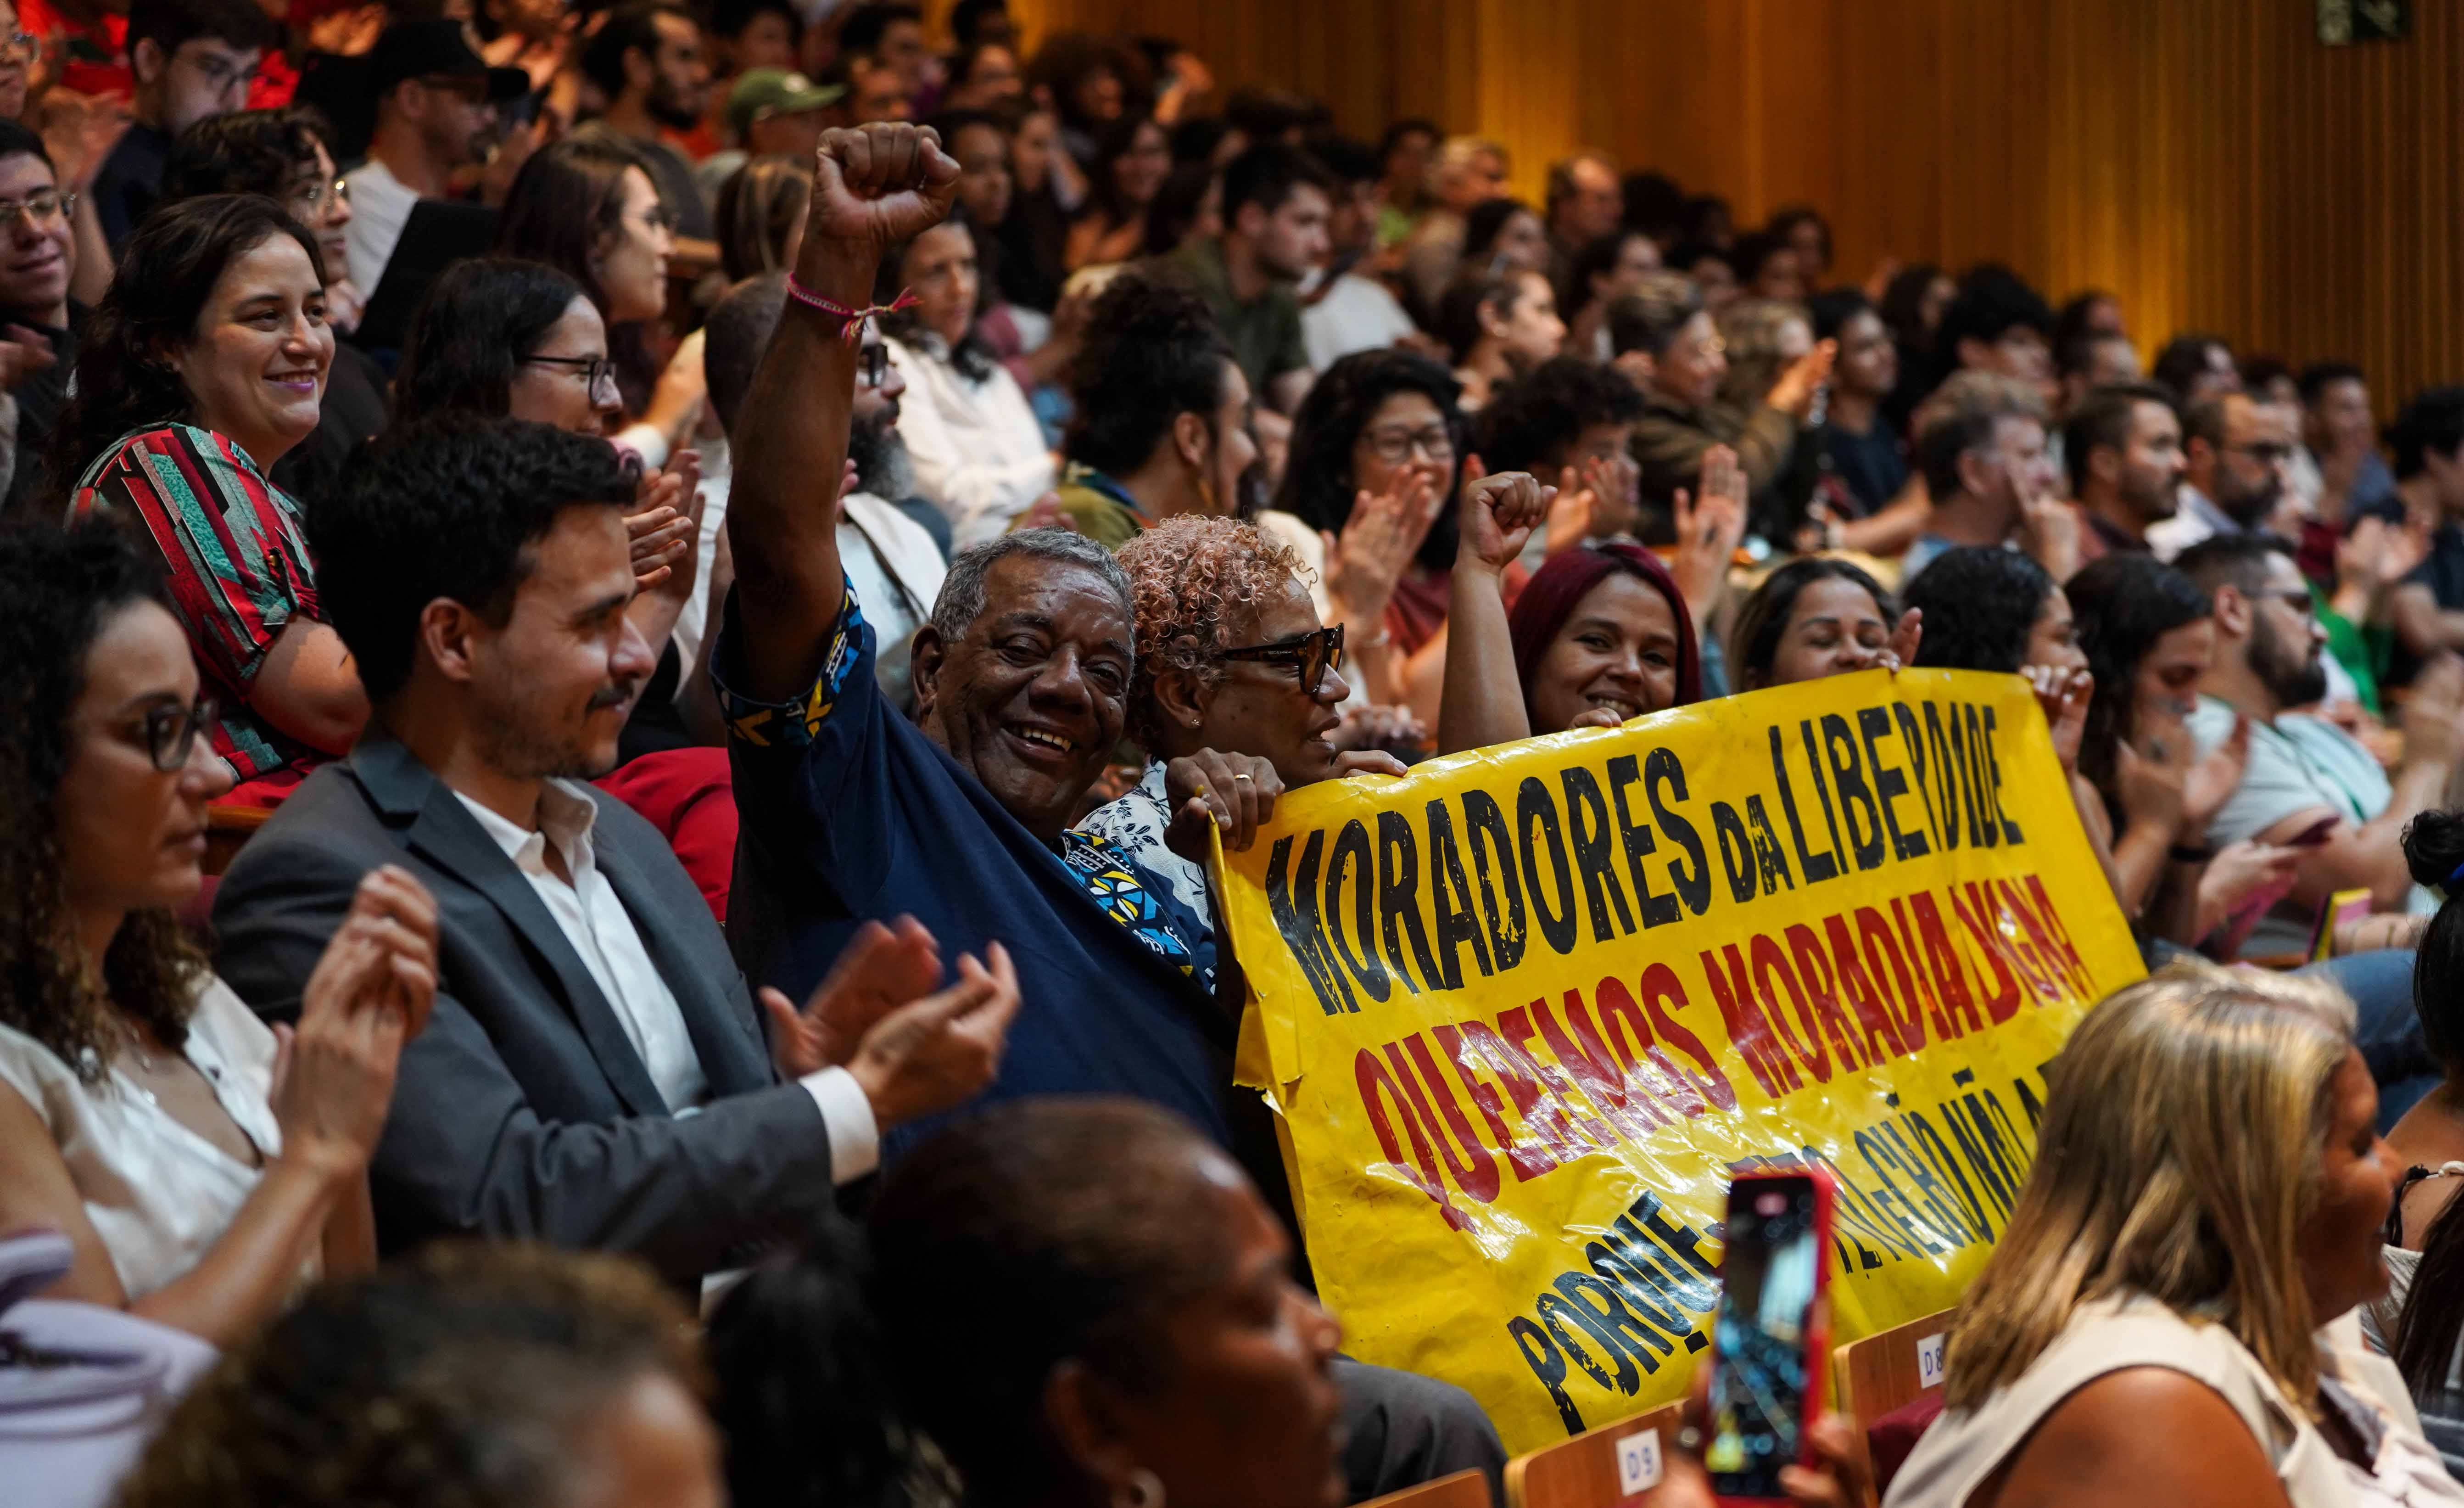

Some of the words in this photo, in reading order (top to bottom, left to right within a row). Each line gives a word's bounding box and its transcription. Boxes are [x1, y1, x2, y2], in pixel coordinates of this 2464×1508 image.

[1265, 747, 1711, 1016] MORADORES
[1710, 794, 1794, 903] DA
[1354, 962, 1737, 1234] QUEREMOS
[1699, 890, 1984, 1098] MORADIA
[1507, 1190, 1723, 1436] PORQUE
